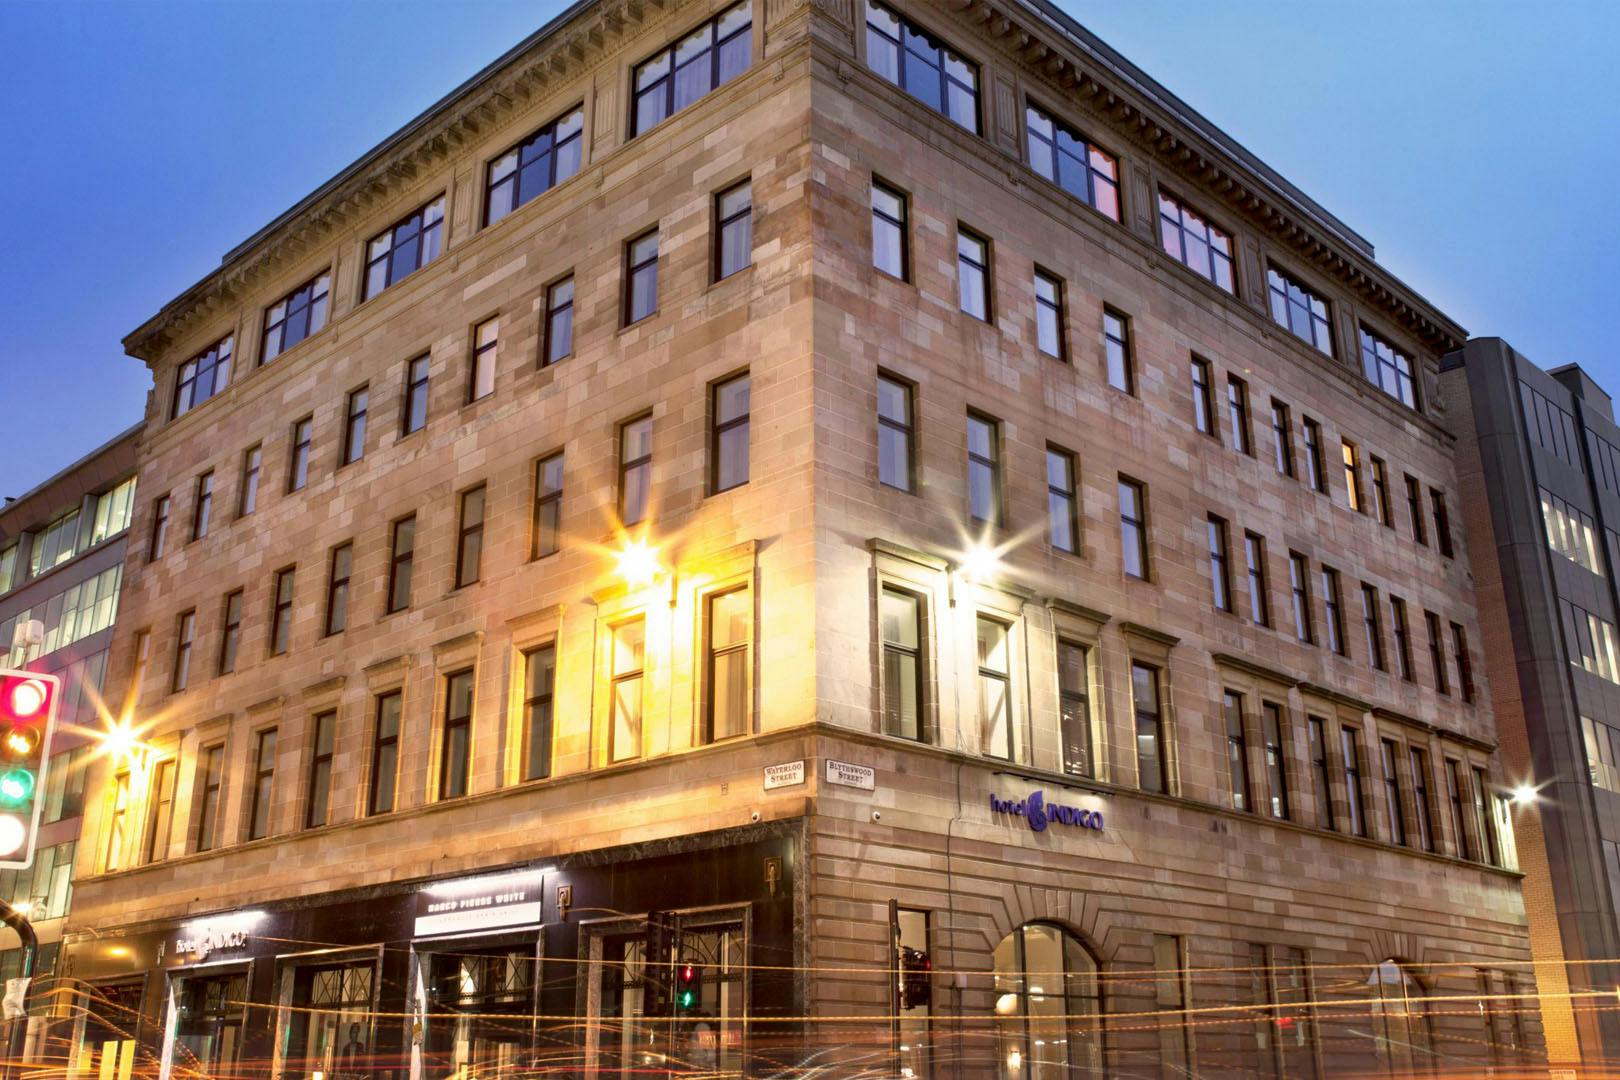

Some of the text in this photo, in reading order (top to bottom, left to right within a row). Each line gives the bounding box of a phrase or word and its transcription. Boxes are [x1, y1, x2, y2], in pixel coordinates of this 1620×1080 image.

[766, 763, 802, 776] WATERLOO
[829, 761, 872, 776] BLYTHSWOOD
[770, 772, 798, 783] STREET
[838, 771, 864, 784] STREET
[990, 793, 1104, 831] hotel INDIGO
